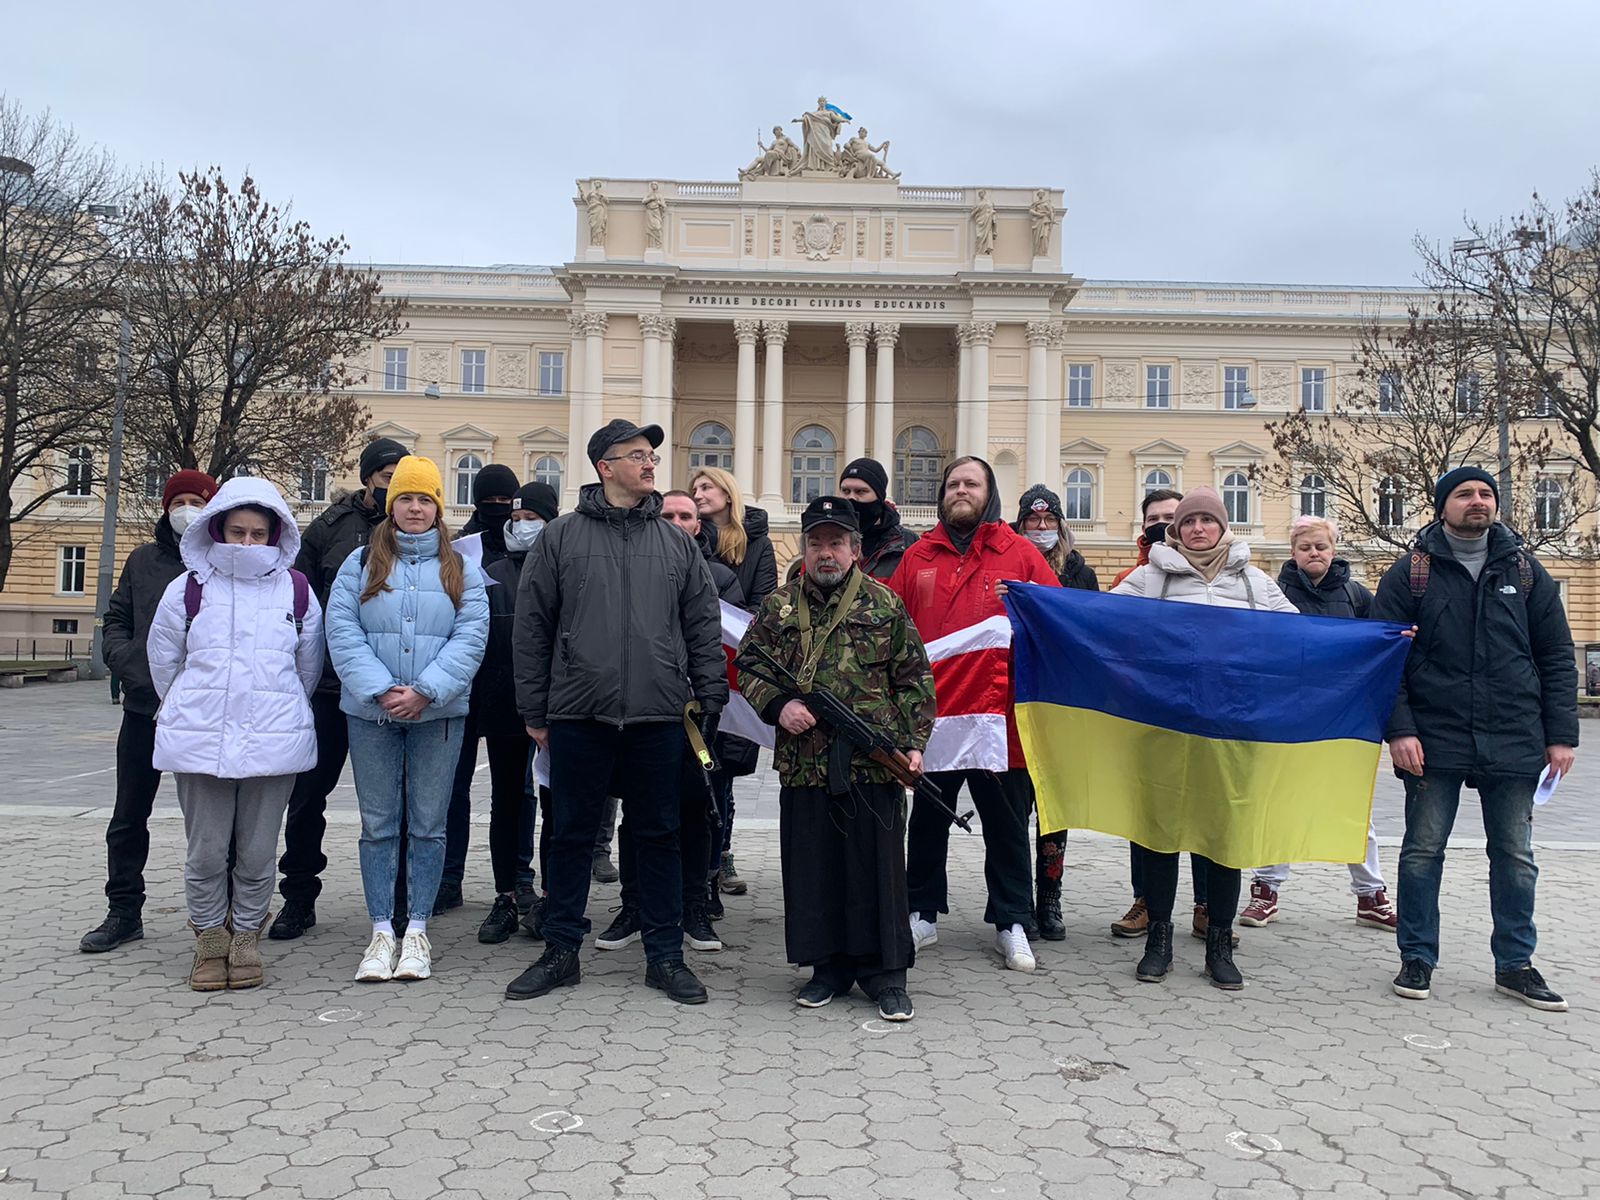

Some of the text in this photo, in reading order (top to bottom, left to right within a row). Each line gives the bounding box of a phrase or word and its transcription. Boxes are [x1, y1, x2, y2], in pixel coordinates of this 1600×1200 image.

[689, 296, 945, 309] PATRIAE DECORI CIVIBUS EDUCANDIS
